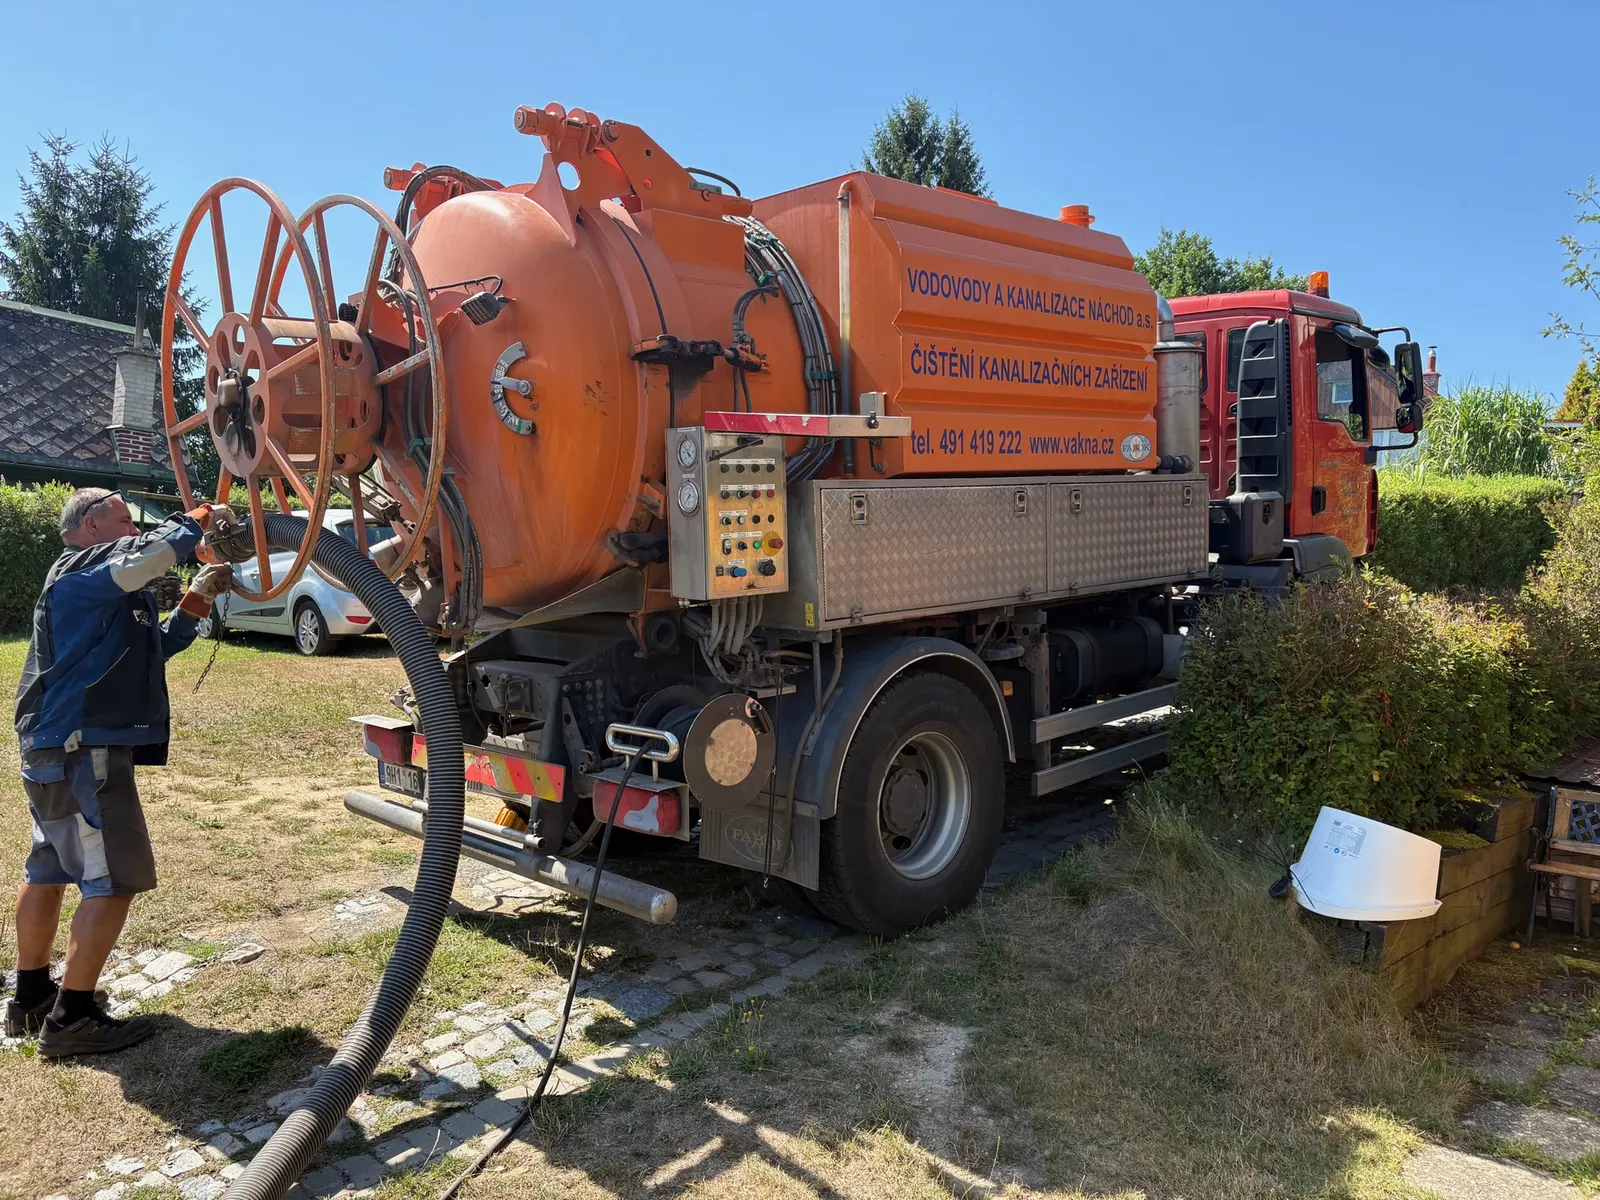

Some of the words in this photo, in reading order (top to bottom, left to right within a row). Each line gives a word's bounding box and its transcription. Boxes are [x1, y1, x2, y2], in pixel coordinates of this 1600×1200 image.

[907, 267, 991, 304] VODOVODY
[994, 283, 1004, 306] A
[1007, 285, 1085, 319] KANALIZACE
[1088, 296, 1134, 327] NÁCHOD
[1136, 312, 1154, 329] a.s.
[910, 342, 975, 379] ČIŠTĚNÍ
[979, 356, 1092, 388] KANALIZAČNÍCH
[1094, 363, 1148, 392] ZAŘÍZENÍ
[910, 428, 934, 455] tel.
[939, 428, 965, 454] 491
[969, 429, 995, 455] 419
[998, 429, 1022, 455] 222
[1029, 431, 1115, 455] www.vakna.cz
